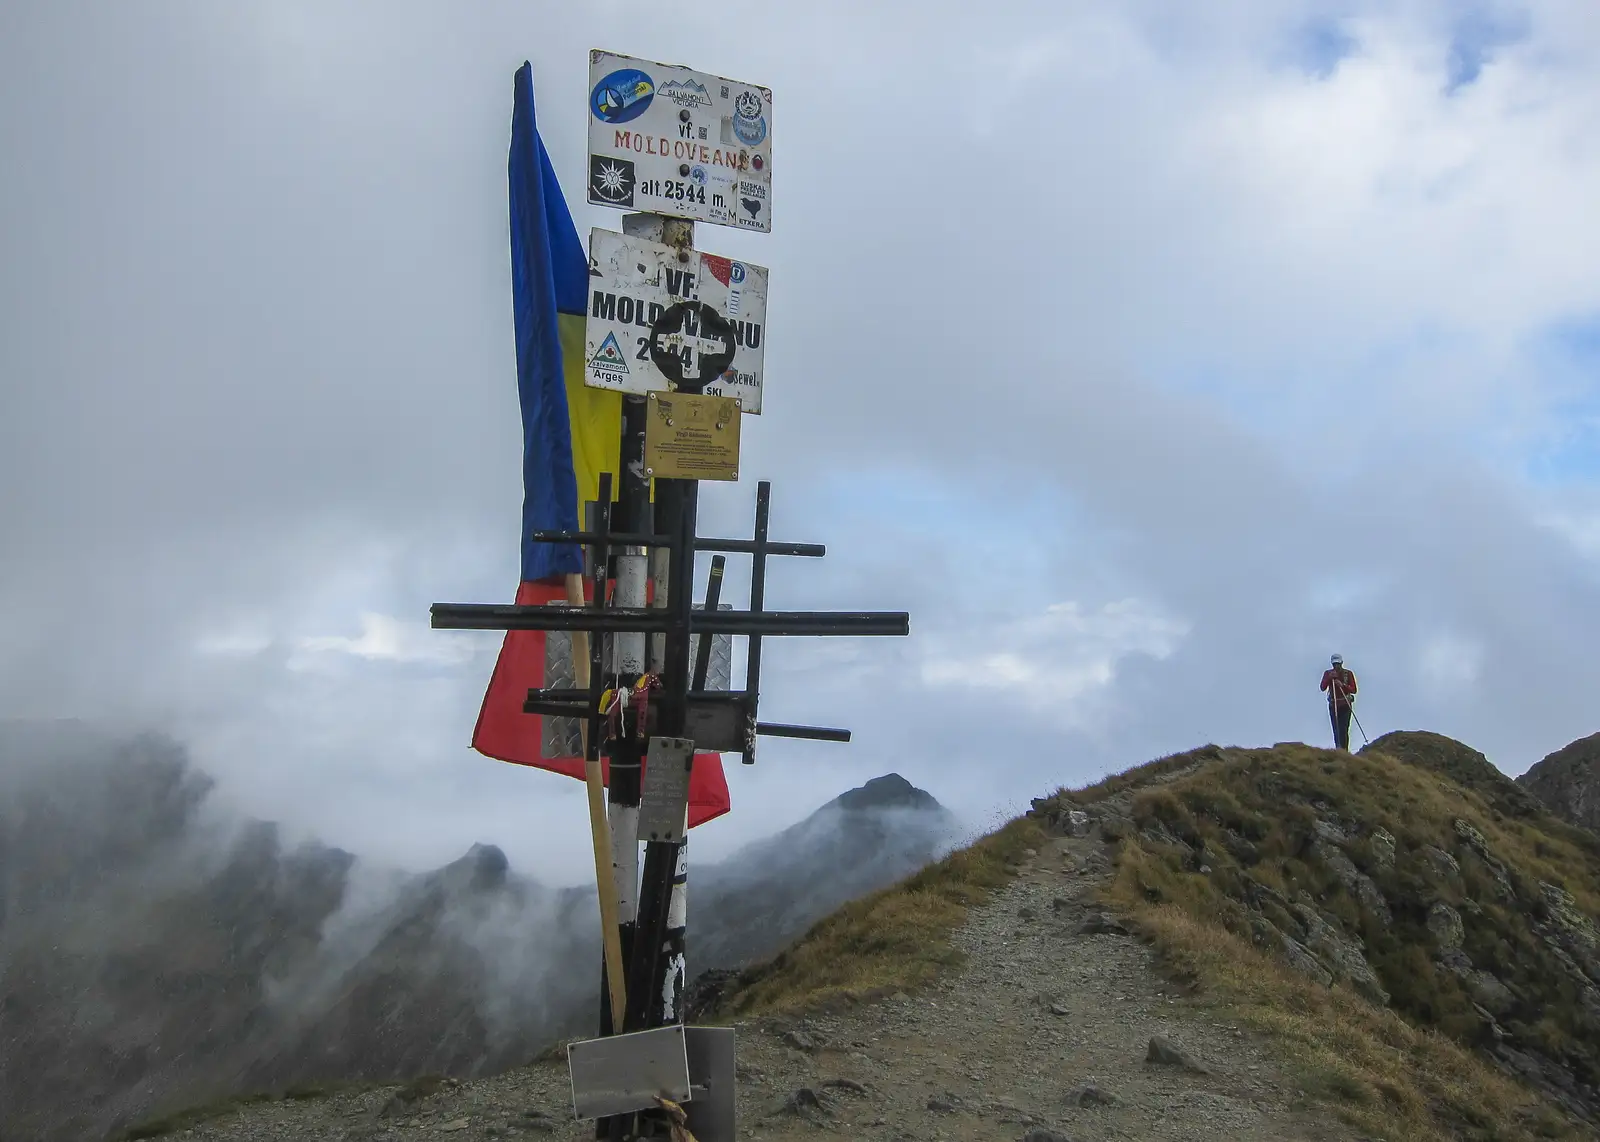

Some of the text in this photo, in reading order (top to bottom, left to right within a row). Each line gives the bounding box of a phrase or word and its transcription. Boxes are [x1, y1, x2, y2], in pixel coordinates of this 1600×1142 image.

[667, 89, 704, 103] SALVAMONT
[672, 98, 699, 109] VICTORIA
[678, 122, 695, 140] vf.
[614, 130, 749, 171] MOLDOVEAN
[641, 180, 662, 197] alt.
[664, 180, 706, 205] 2544
[712, 193, 727, 208] m.
[738, 218, 765, 229] ETXERA
[666, 267, 699, 301] VF.
[592, 290, 761, 350] MOLDVNU
[591, 361, 626, 371] salvamont
[593, 369, 624, 385] Argeș
[706, 386, 722, 398] SKI
